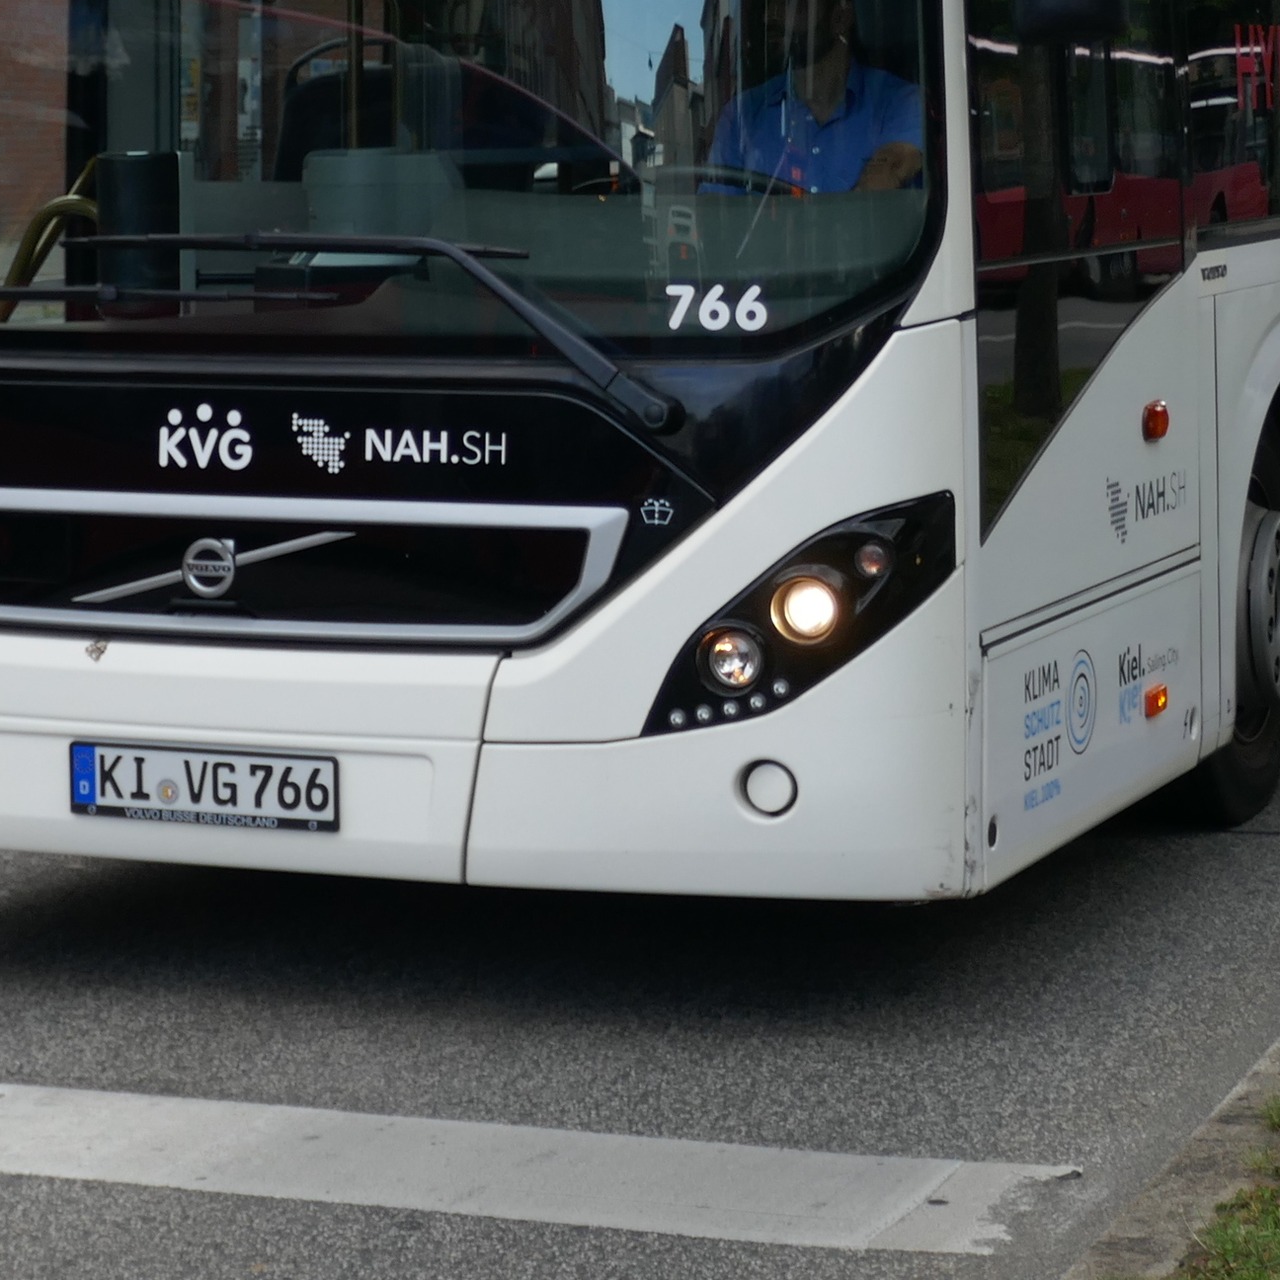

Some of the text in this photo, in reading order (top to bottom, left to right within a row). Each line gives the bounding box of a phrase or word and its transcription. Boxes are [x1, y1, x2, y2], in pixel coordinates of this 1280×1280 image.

[665, 284, 768, 331] 766
[158, 425, 253, 471] KVG
[364, 428, 507, 466] NAH.SH
[1135, 469, 1187, 522] NAH.SH
[186, 563, 231, 573] VOLVO
[1024, 660, 1060, 703] KLIMA
[1119, 643, 1145, 687] Kiel.
[1024, 701, 1062, 740] SCHUTZ
[1024, 735, 1061, 781] STADT
[79, 781, 90, 795] D
[99, 754, 330, 812] KI VG 766
[124, 807, 278, 829] VOLVO BUSSE DEUTSCHLAND
